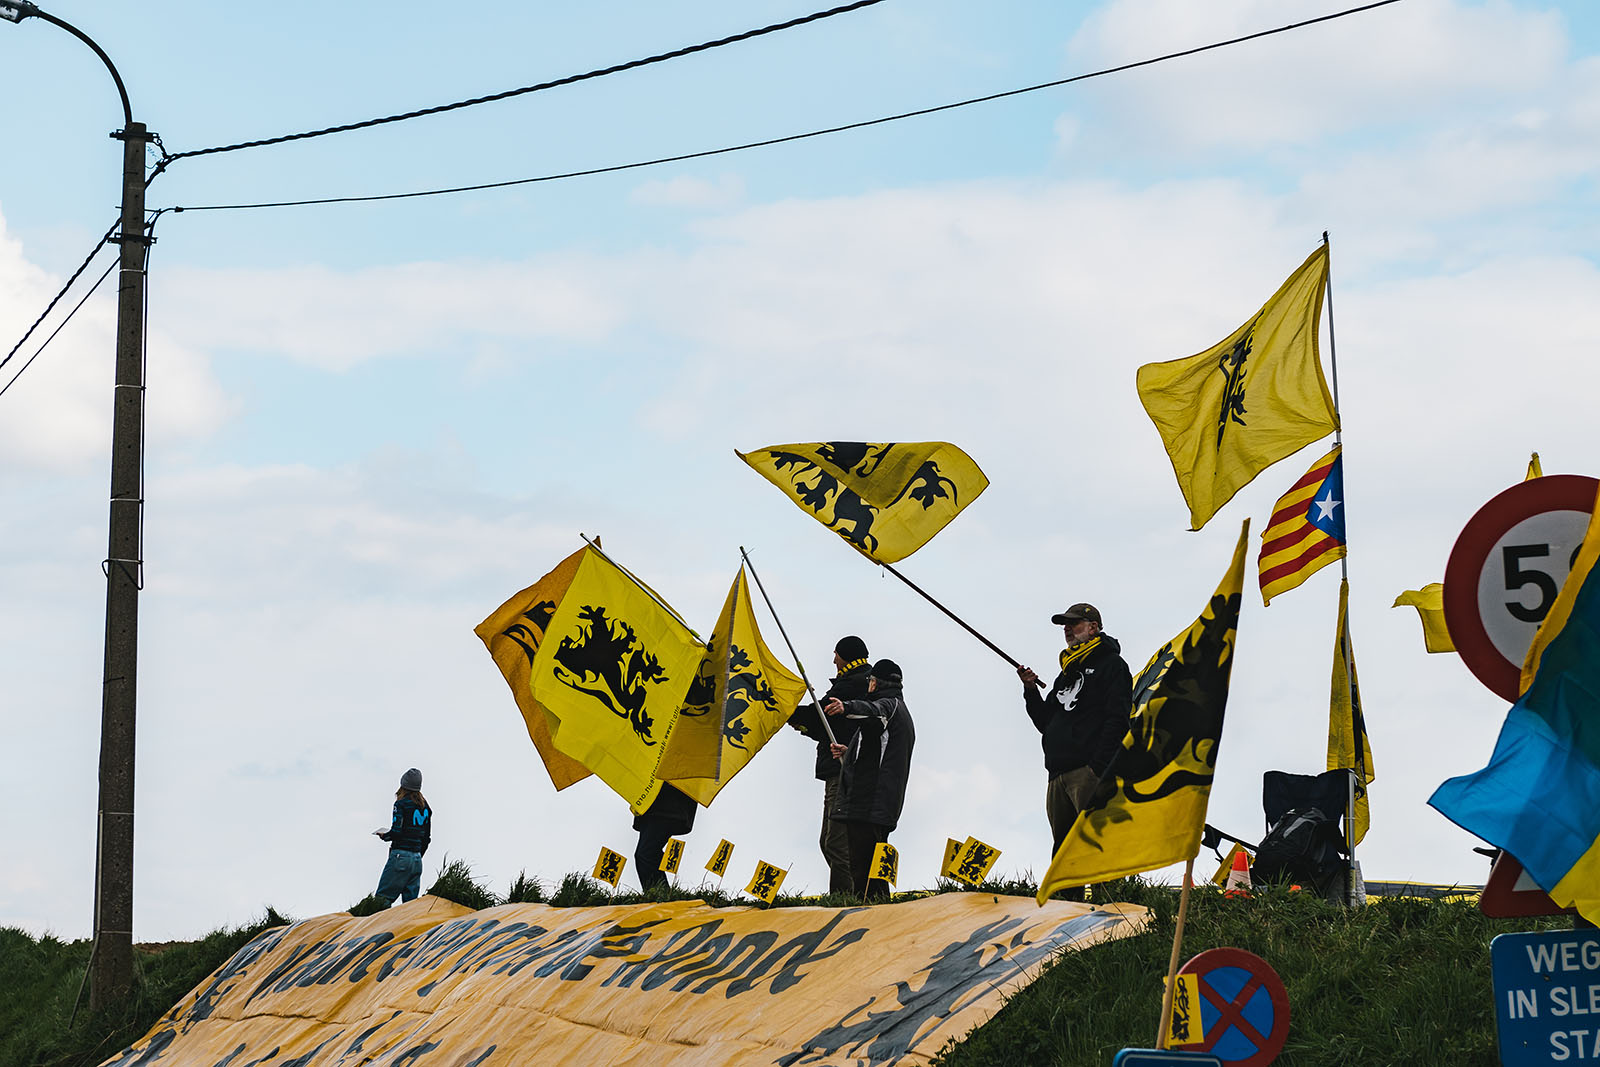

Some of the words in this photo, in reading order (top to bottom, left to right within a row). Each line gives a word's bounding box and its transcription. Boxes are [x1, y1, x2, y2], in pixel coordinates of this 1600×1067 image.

[1503, 543, 1584, 623] 5
[1526, 940, 1600, 973] WEG
[1507, 988, 1538, 1019] IN
[1550, 985, 1600, 1016] SLE
